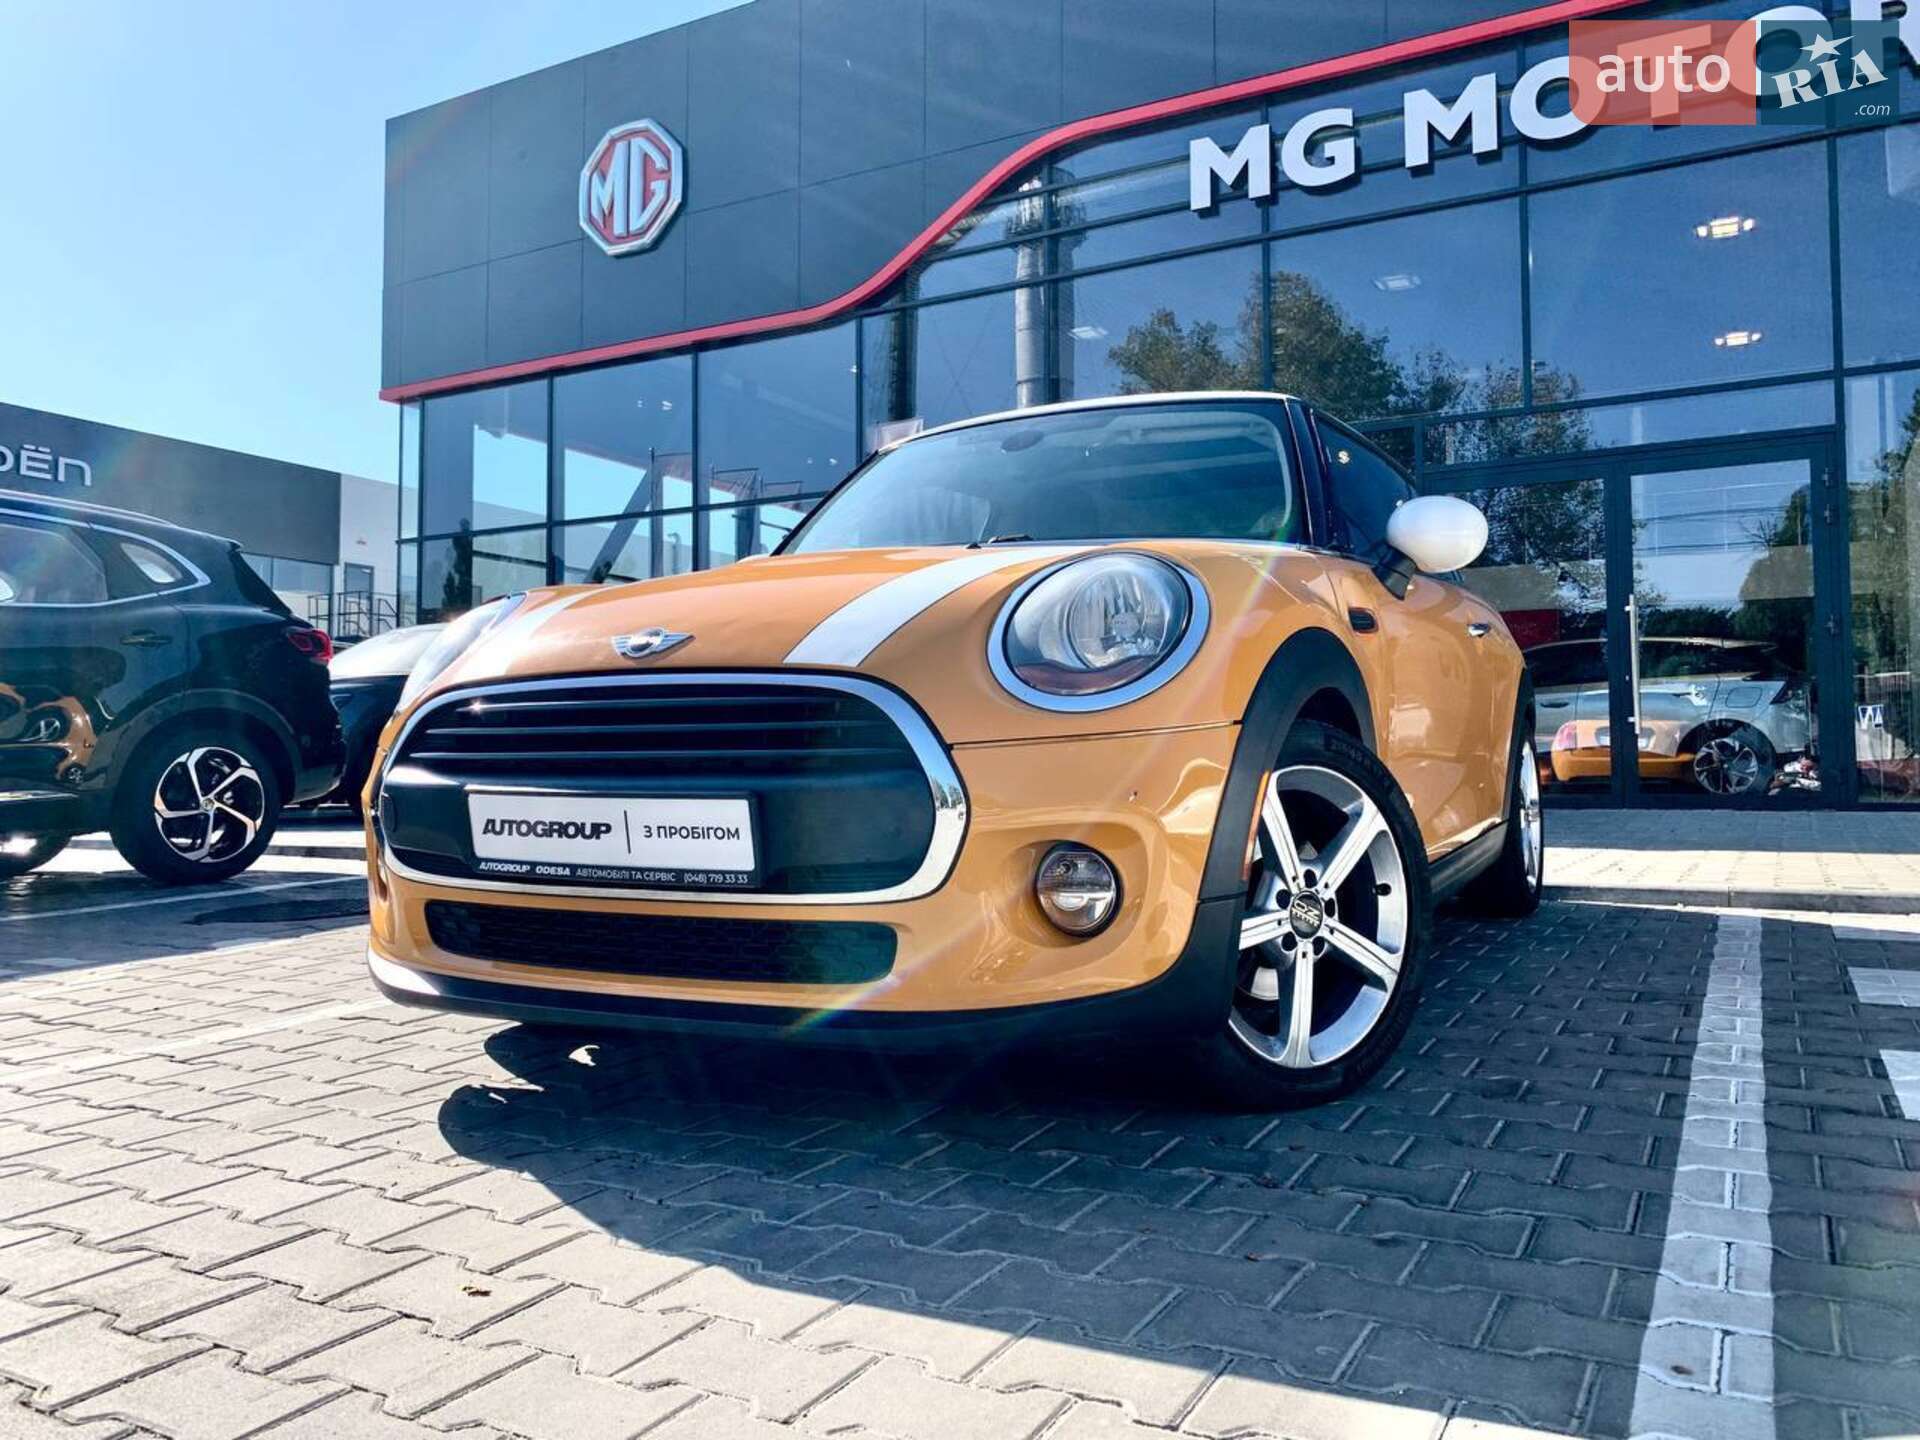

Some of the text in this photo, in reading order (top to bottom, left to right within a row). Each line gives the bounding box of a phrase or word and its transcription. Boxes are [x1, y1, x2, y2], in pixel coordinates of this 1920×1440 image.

[1189, 108, 1357, 211] MG
[591, 137, 670, 236] MG
[482, 818, 612, 840] AUTOGROUP
[657, 826, 740, 840] ПРОБІГОМ
[479, 861, 531, 873] AUTOGROUP
[535, 865, 571, 876] ODESA
[575, 868, 630, 879] АВТОМОБІЛІ
[644, 871, 677, 882] СЕРВІС
